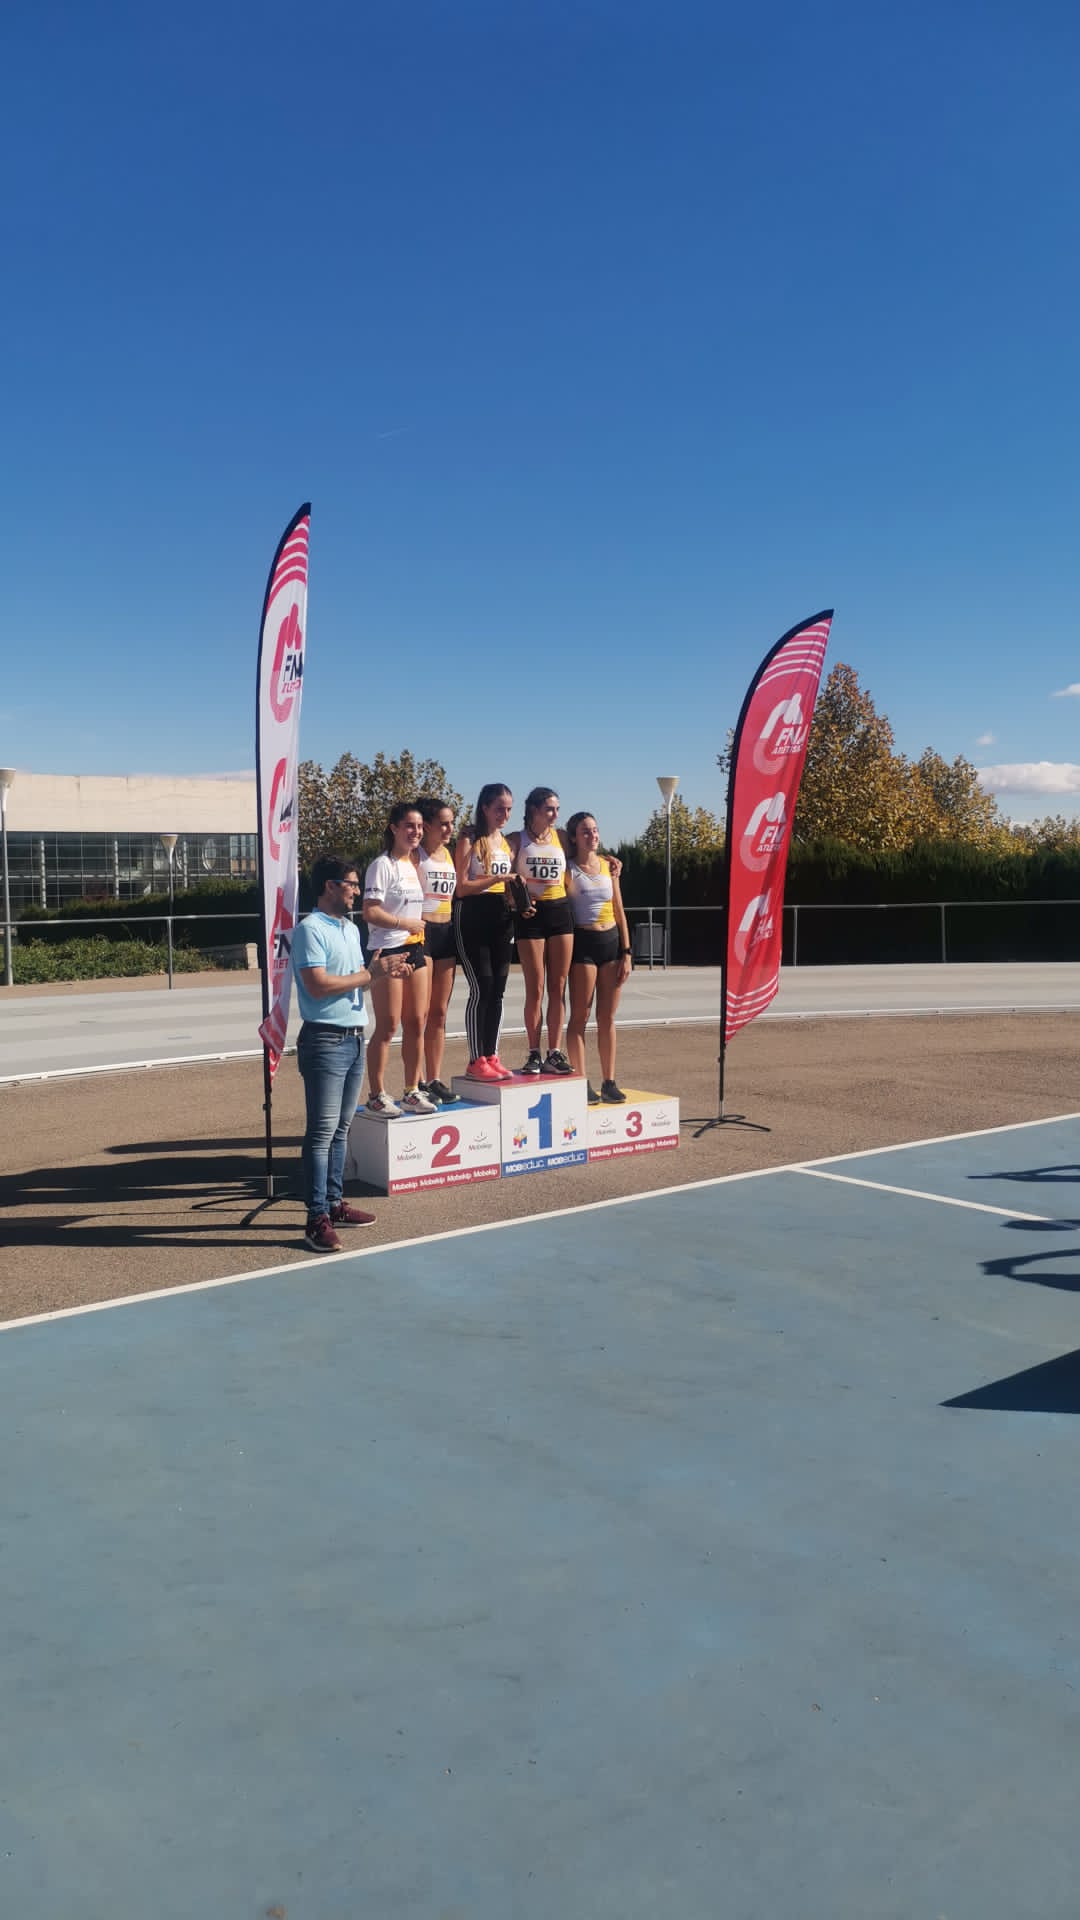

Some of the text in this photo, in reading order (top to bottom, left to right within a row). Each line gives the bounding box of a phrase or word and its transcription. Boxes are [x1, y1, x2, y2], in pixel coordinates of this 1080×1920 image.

[283, 652, 304, 682] FN
[760, 825, 786, 845] FN
[491, 862, 508, 875] 06
[529, 865, 559, 878] 105
[528, 1093, 553, 1149] 1
[625, 1110, 643, 1138] 3
[431, 1125, 461, 1168] 2
